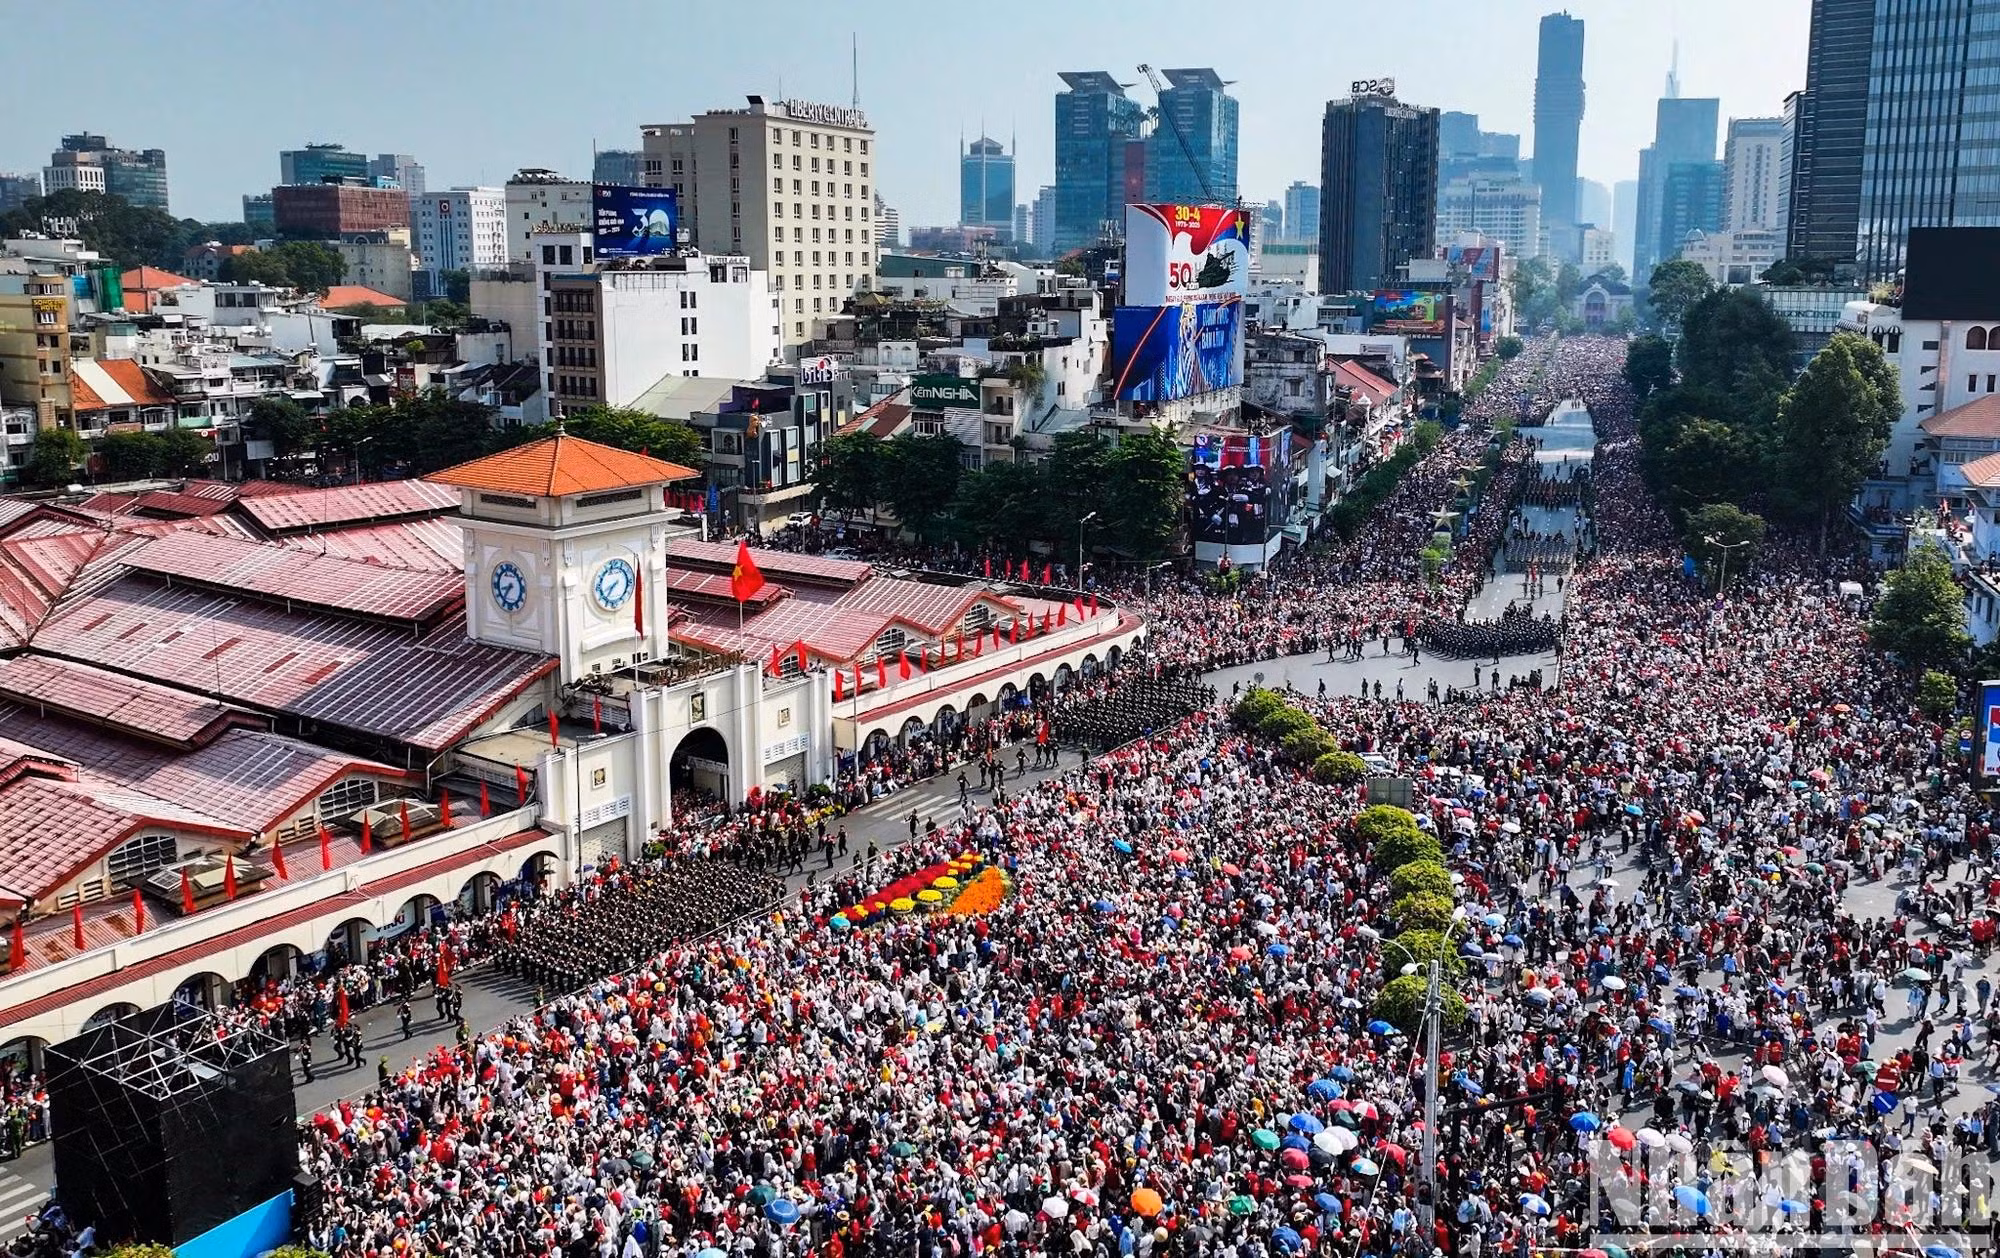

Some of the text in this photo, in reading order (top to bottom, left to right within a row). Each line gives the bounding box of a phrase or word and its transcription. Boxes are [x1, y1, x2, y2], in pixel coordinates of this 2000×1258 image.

[790, 99, 824, 122] LIBERTY
[1175, 206, 1200, 221] 30-4
[1169, 263, 1192, 288] 50
